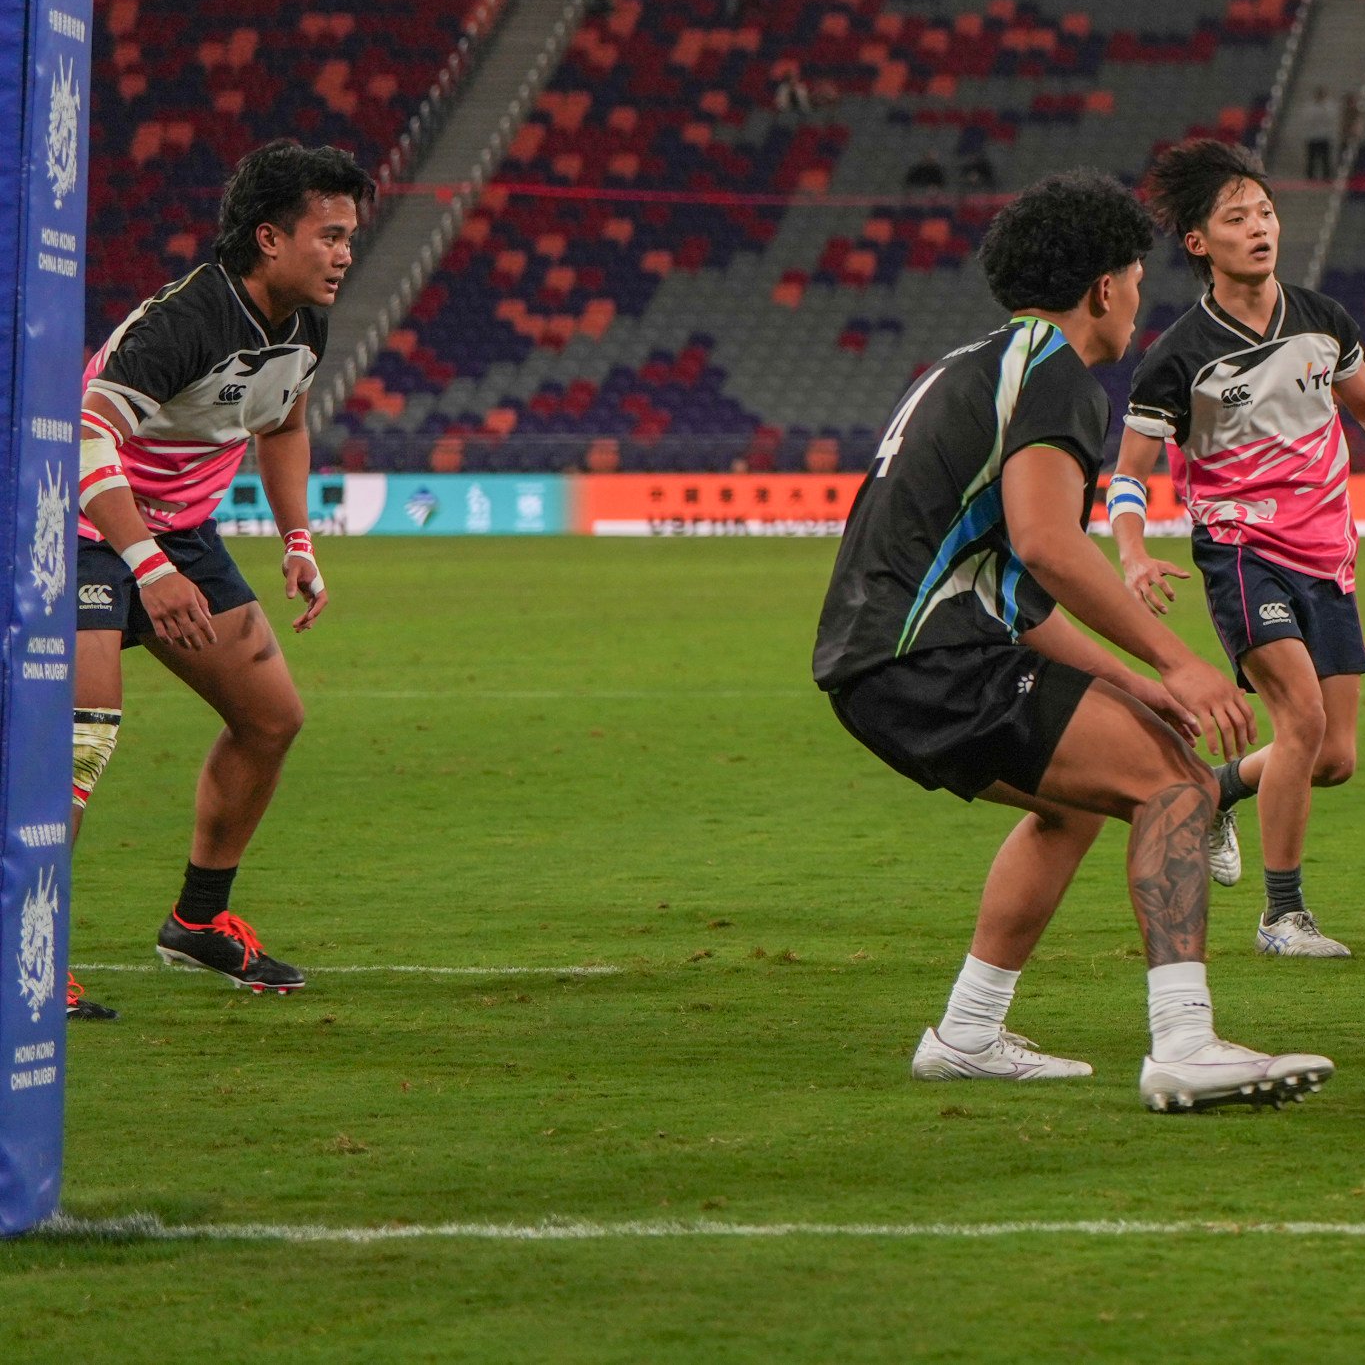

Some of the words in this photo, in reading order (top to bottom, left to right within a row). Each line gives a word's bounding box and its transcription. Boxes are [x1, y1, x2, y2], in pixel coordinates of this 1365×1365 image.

[41, 227, 59, 248] HONG
[59, 232, 76, 252] KONG
[38, 252, 57, 273] CHINA
[57, 257, 78, 278] RUGBY
[1295, 362, 1331, 393] VTC
[875, 367, 946, 478] 4
[78, 603, 113, 612] canterbury
[27, 636, 46, 654] HONG
[46, 637, 65, 655] KONG
[22, 661, 44, 680] CHINA
[44, 662, 69, 681] RUGBY
[15, 1044, 36, 1064] HONG
[36, 1040, 55, 1060] KONG
[11, 1071, 33, 1091] CHINA
[33, 1066, 57, 1086] RUGBY
